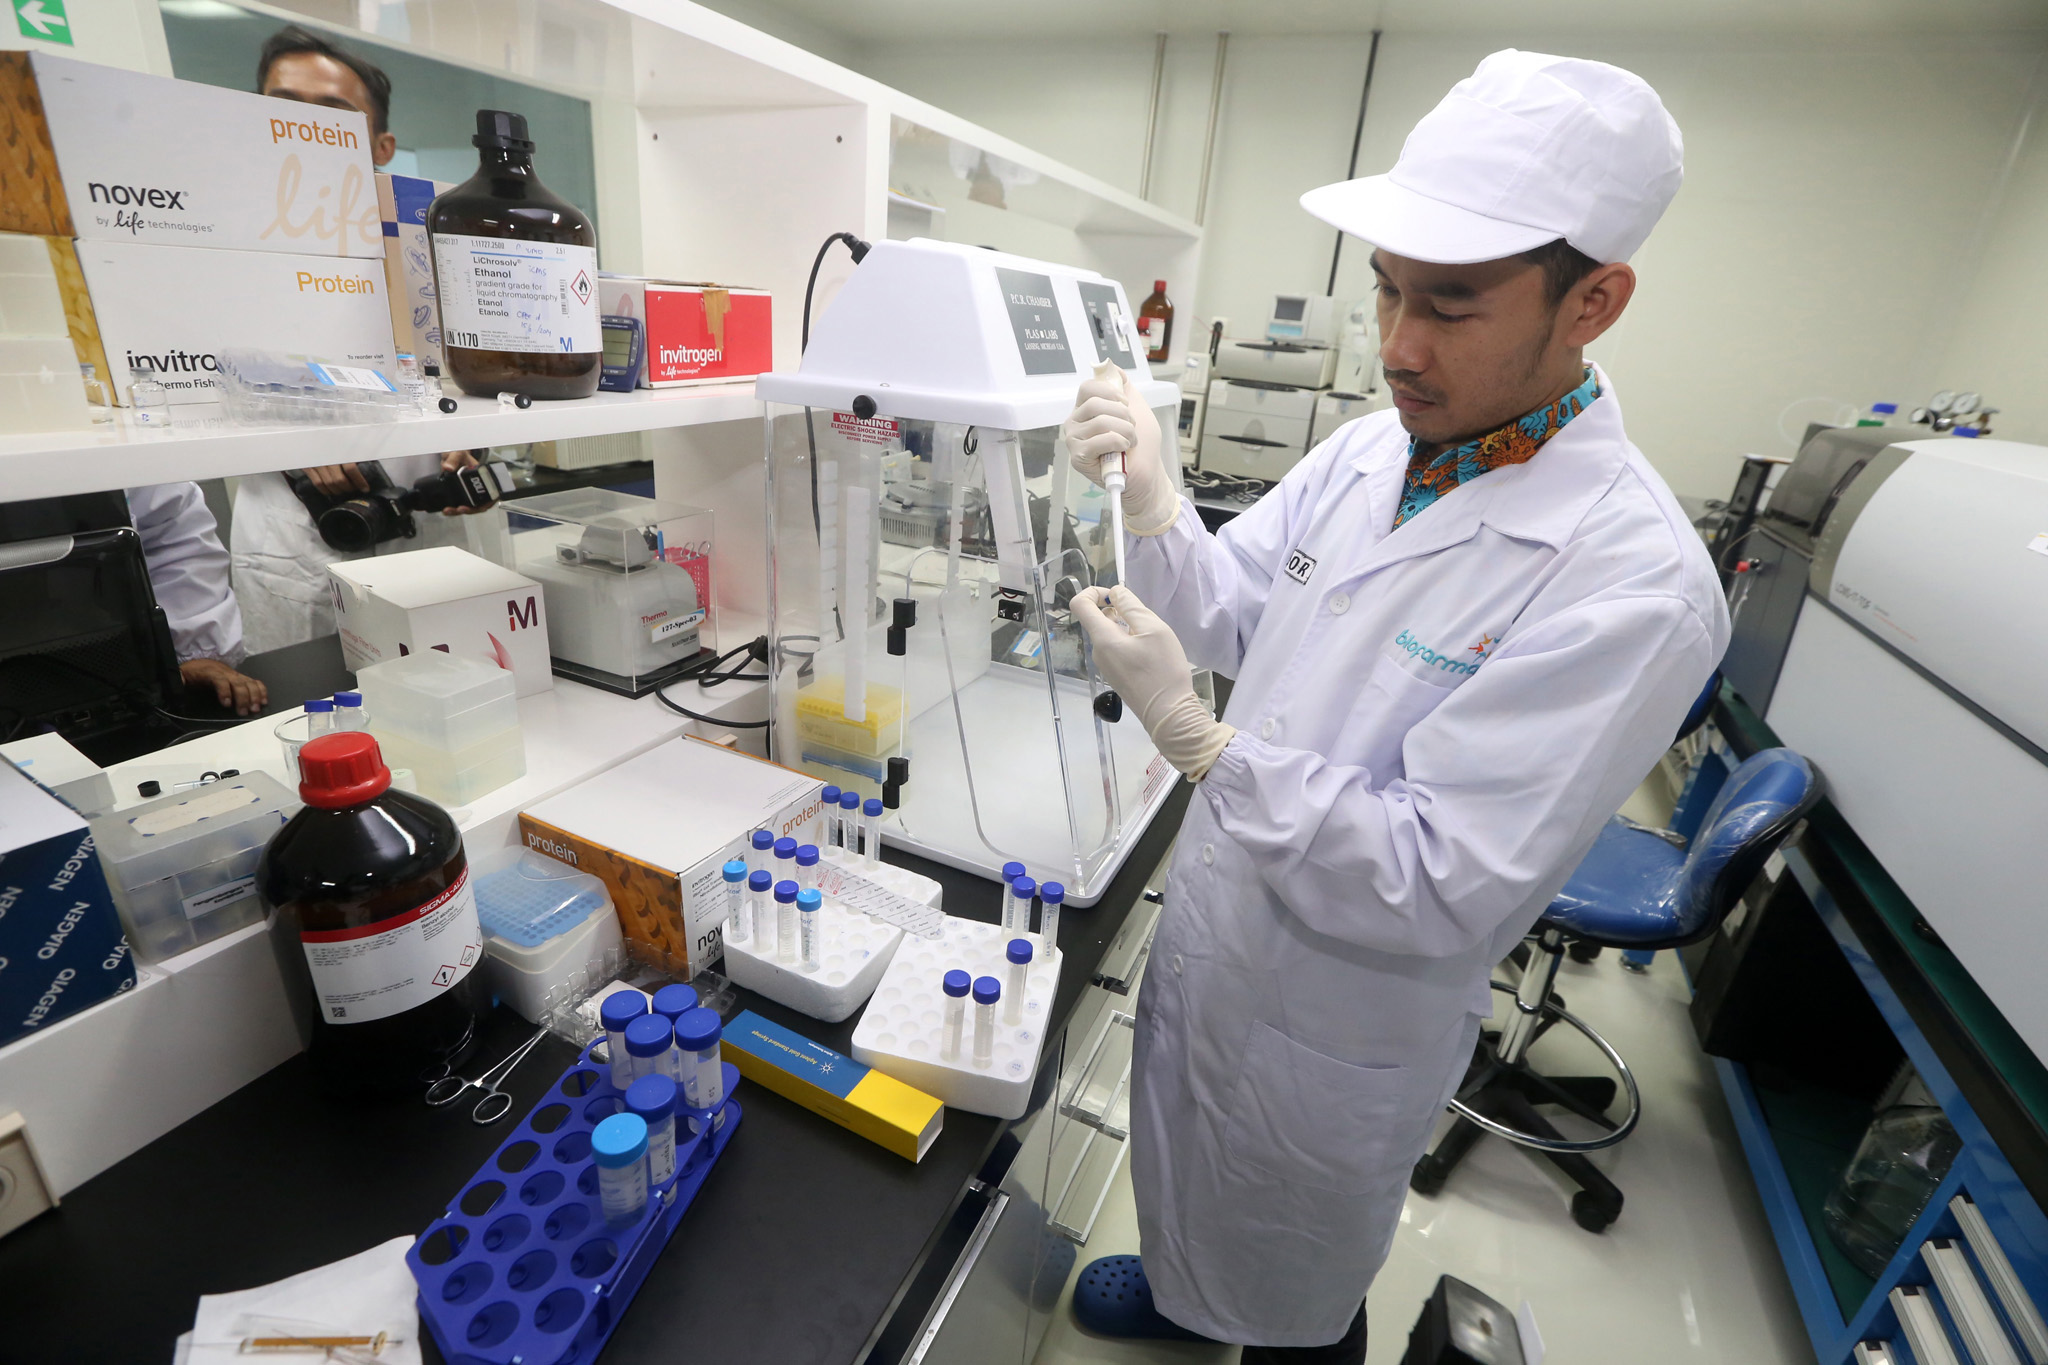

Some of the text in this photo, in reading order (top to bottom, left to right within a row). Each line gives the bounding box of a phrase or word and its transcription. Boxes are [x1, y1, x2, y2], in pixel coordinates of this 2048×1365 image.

[269, 117, 359, 150] protein
[96, 216, 109, 227] by
[114, 210, 144, 235] life
[474, 267, 512, 279] Ethanol
[296, 271, 375, 295] Protein
[475, 279, 542, 292] gradient grade for
[476, 289, 558, 303] liquid chromatography
[477, 298, 503, 307] Etanol
[1026, 295, 1052, 308] CHAMBER
[478, 308, 509, 318] Etanolo
[457, 332, 479, 348] 1170
[1024, 328, 1059, 340] PLAS LABS
[559, 336, 573, 353] M
[659, 344, 722, 367] invitrogen
[153, 378, 215, 391] hermo Fish
[839, 414, 892, 429] WARNING
[831, 422, 901, 439] ELECTRIC SHOCK HAZARD
[1287, 555, 1311, 578] OR
[506, 596, 538, 632] M
[640, 610, 668, 624] Thermo
[661, 614, 697, 633] 127-Spec-03
[1394, 628, 1482, 677] biofarma
[783, 799, 824, 838] protein
[527, 830, 578, 865] protein
[48, 834, 96, 892] QIAGEN
[36, 901, 91, 960] QIAGEN
[22, 967, 77, 1027] QIAGEN
[767, 1038, 790, 1053] Standard
